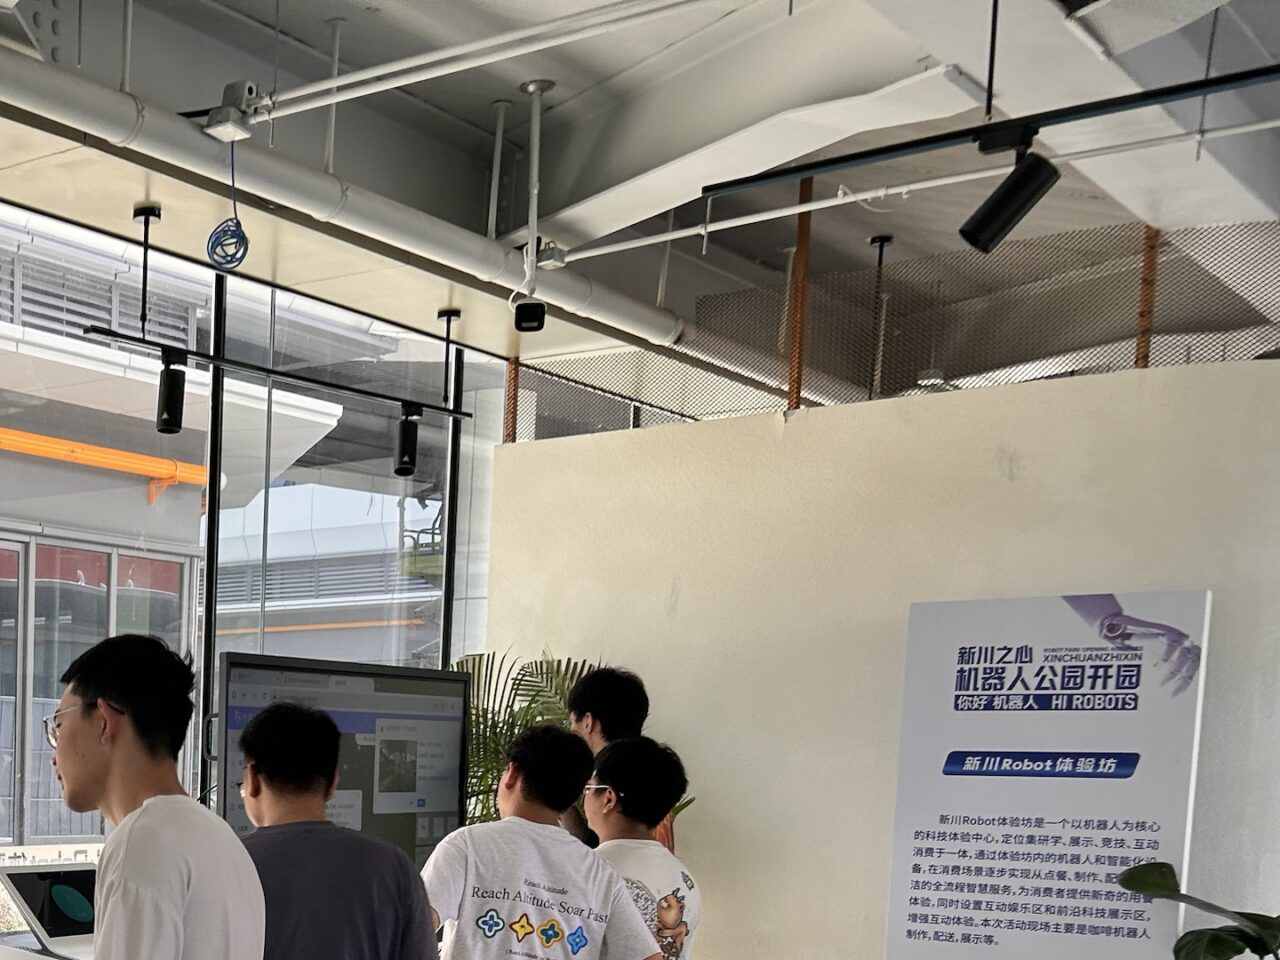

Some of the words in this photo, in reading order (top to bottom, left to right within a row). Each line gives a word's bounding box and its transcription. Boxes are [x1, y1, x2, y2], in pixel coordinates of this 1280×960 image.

[957, 645, 1033, 665] 新川之心
[1043, 652, 1143, 662] XINCHUANZHIXIN
[955, 664, 1142, 692] 机器人公园开园
[957, 695, 987, 710] 你好
[992, 695, 1039, 710] 机器人
[1051, 695, 1067, 709] HI
[1072, 694, 1136, 710] ROBOTS
[471, 886, 510, 901] Reach
[513, 890, 555, 910] Altitude
[558, 900, 585, 917] Soar
